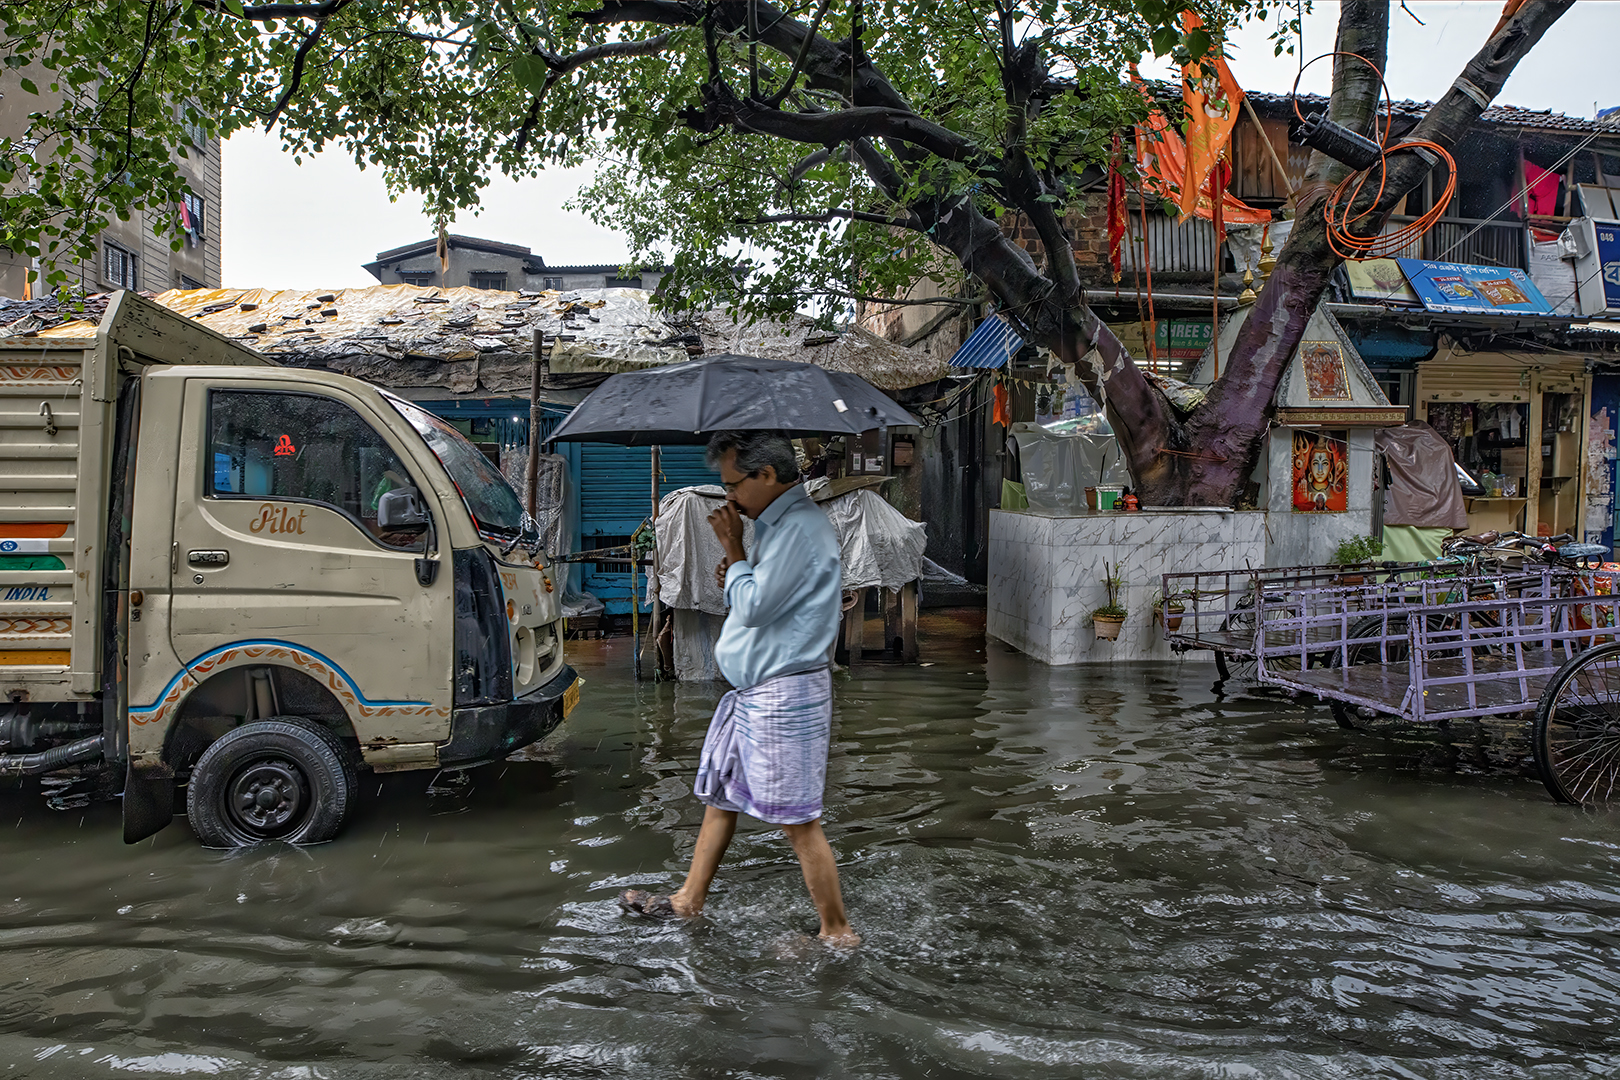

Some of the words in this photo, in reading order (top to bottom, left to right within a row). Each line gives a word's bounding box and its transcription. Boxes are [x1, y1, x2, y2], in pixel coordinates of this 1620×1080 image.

[1160, 324, 1200, 338] SHREE
[249, 503, 308, 535] Pilot
[4, 587, 53, 601] INDIA
